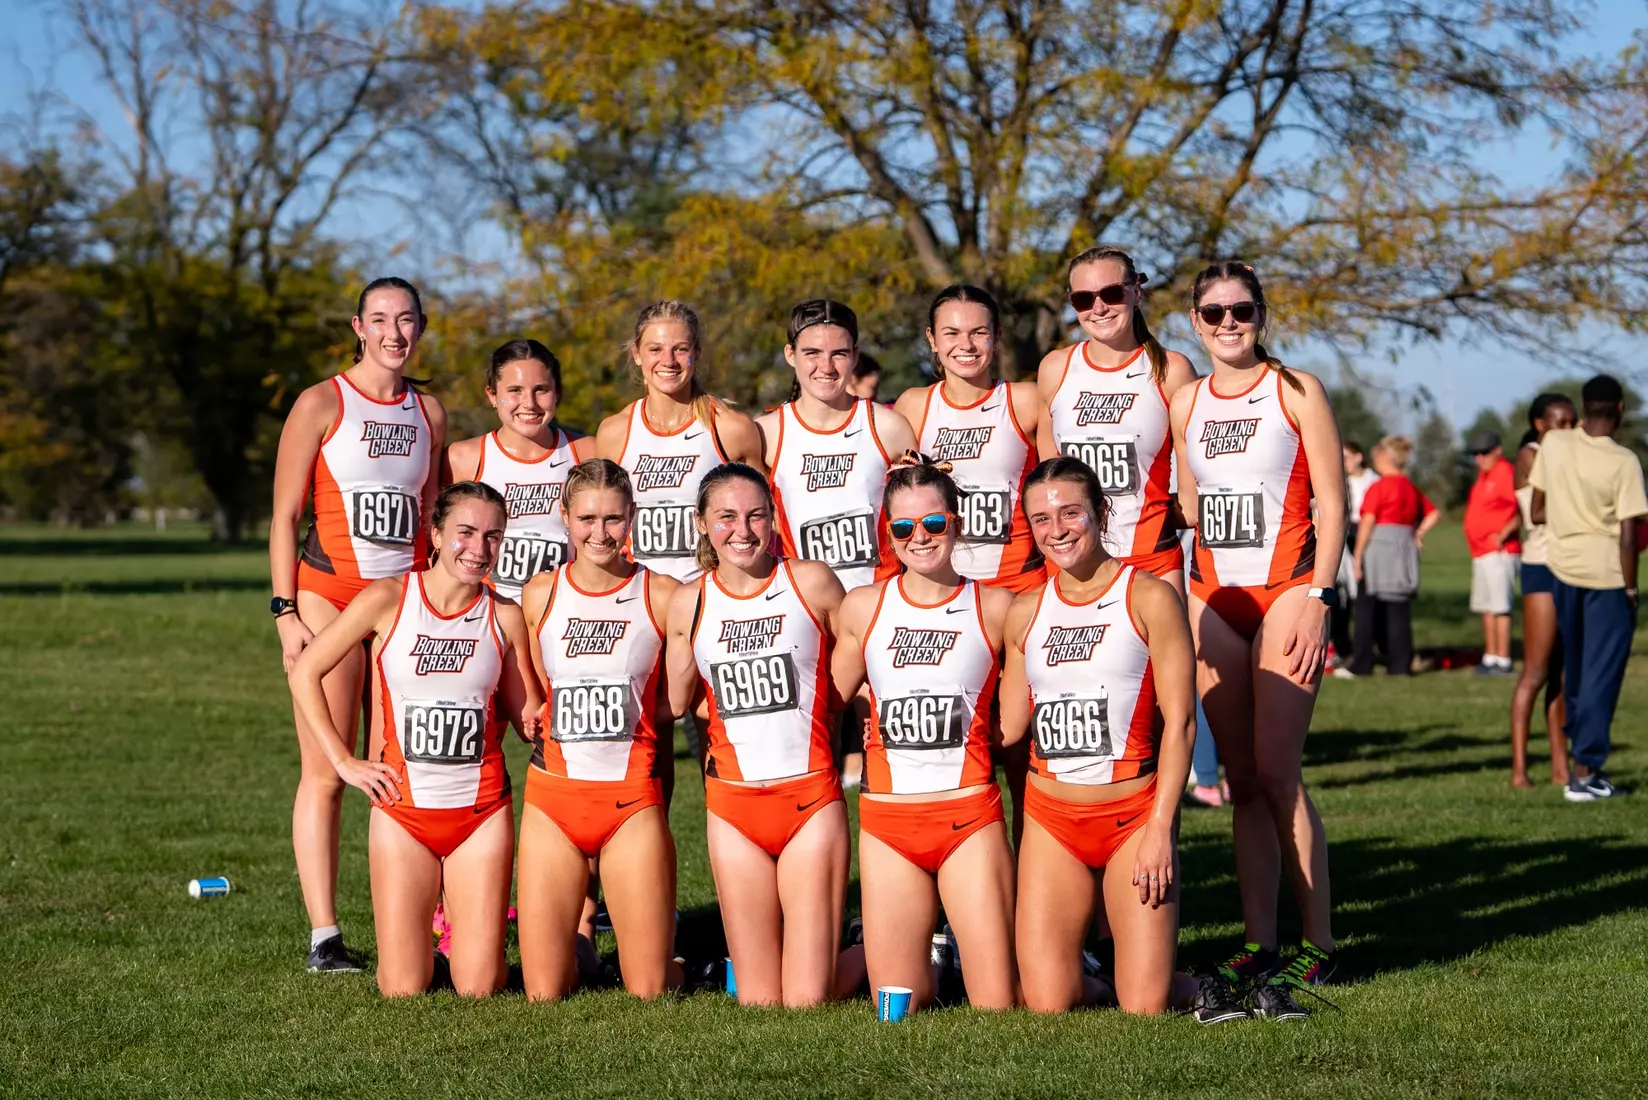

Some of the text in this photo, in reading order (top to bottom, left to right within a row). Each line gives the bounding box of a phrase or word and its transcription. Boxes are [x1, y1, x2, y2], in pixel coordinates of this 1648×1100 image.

[1075, 393, 1134, 409] BOWLING
[1077, 408, 1123, 425] GREEN
[364, 421, 417, 441] BOWLING
[935, 427, 991, 446] BOWLING
[1202, 420, 1257, 440] BOWLING
[370, 440, 411, 457] GREEN
[939, 443, 982, 460] GREEN
[1207, 436, 1248, 458] GREEN
[635, 456, 695, 473] BOWLING
[803, 454, 853, 473] BOWLING
[638, 472, 685, 491] GREEN
[808, 470, 847, 491] GREEN
[505, 484, 561, 500] BOWLING
[359, 493, 413, 539] 6971
[510, 499, 553, 518] GREEN
[957, 493, 1003, 537] 963
[1203, 495, 1257, 541] 6974
[806, 516, 873, 564] 6964
[497, 538, 562, 581] 6973
[565, 620, 625, 638] BOWLING
[721, 616, 781, 640] BOWLING
[892, 628, 955, 648] BOWLING
[1046, 626, 1104, 646] BOWLING
[413, 636, 474, 655] BOWLING
[567, 638, 616, 657] GREEN
[728, 634, 774, 653] GREEN
[894, 647, 945, 667] GREEN
[1048, 643, 1094, 665] GREEN
[417, 655, 466, 674] GREEN
[718, 656, 789, 710] 6969
[557, 686, 625, 735] 6968
[886, 697, 954, 743] 6967
[410, 707, 478, 756] 6972
[1037, 700, 1102, 750] 6966
